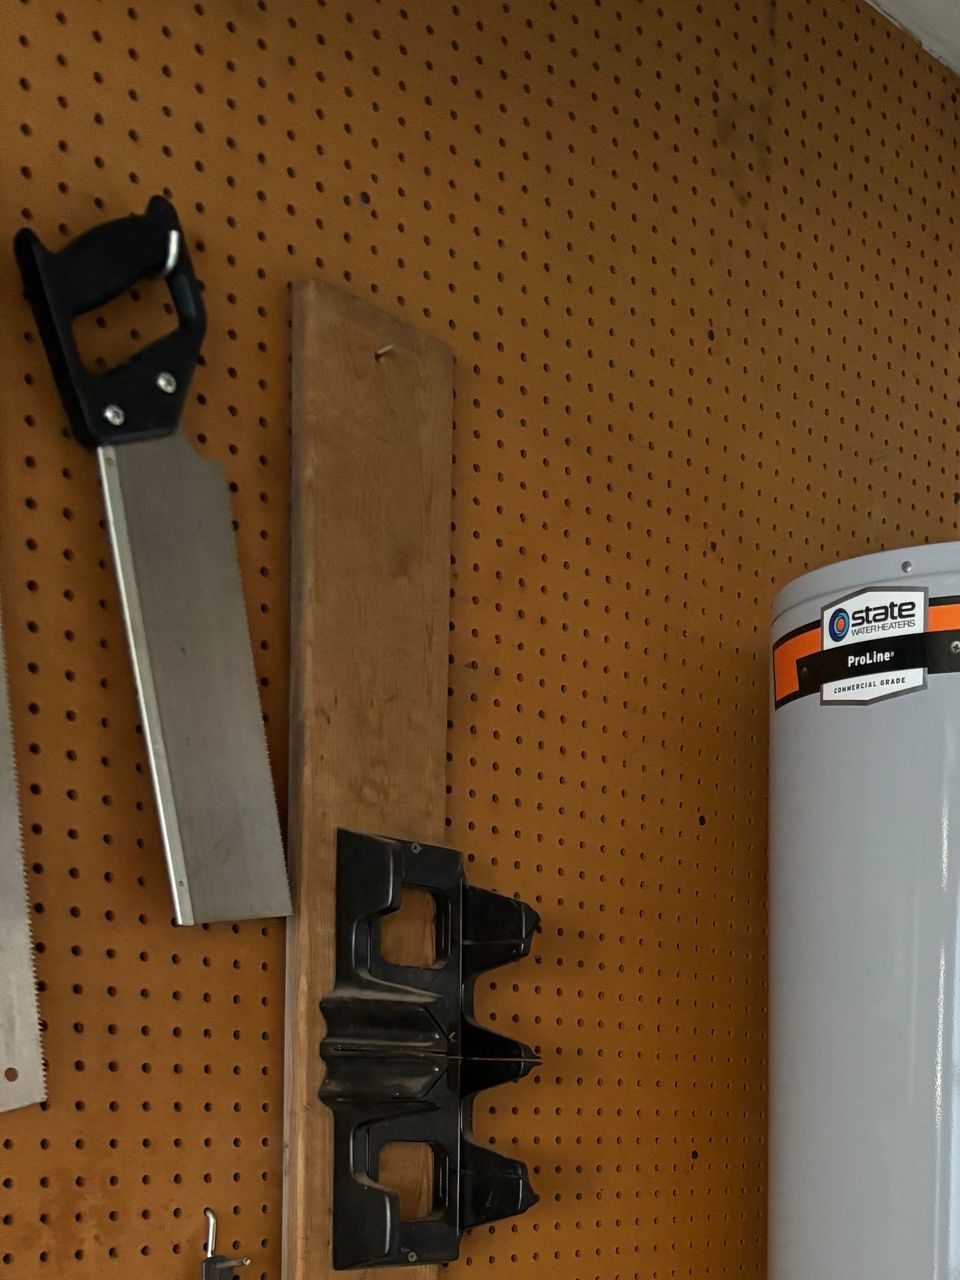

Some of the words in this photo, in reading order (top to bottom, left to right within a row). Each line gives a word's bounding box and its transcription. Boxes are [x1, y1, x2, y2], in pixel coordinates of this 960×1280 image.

[851, 601, 916, 627] state
[852, 626, 876, 636] WATER
[877, 620, 915, 632] HEATERS
[834, 681, 876, 694] COMMERCIAL
[880, 677, 906, 686] GRADE
